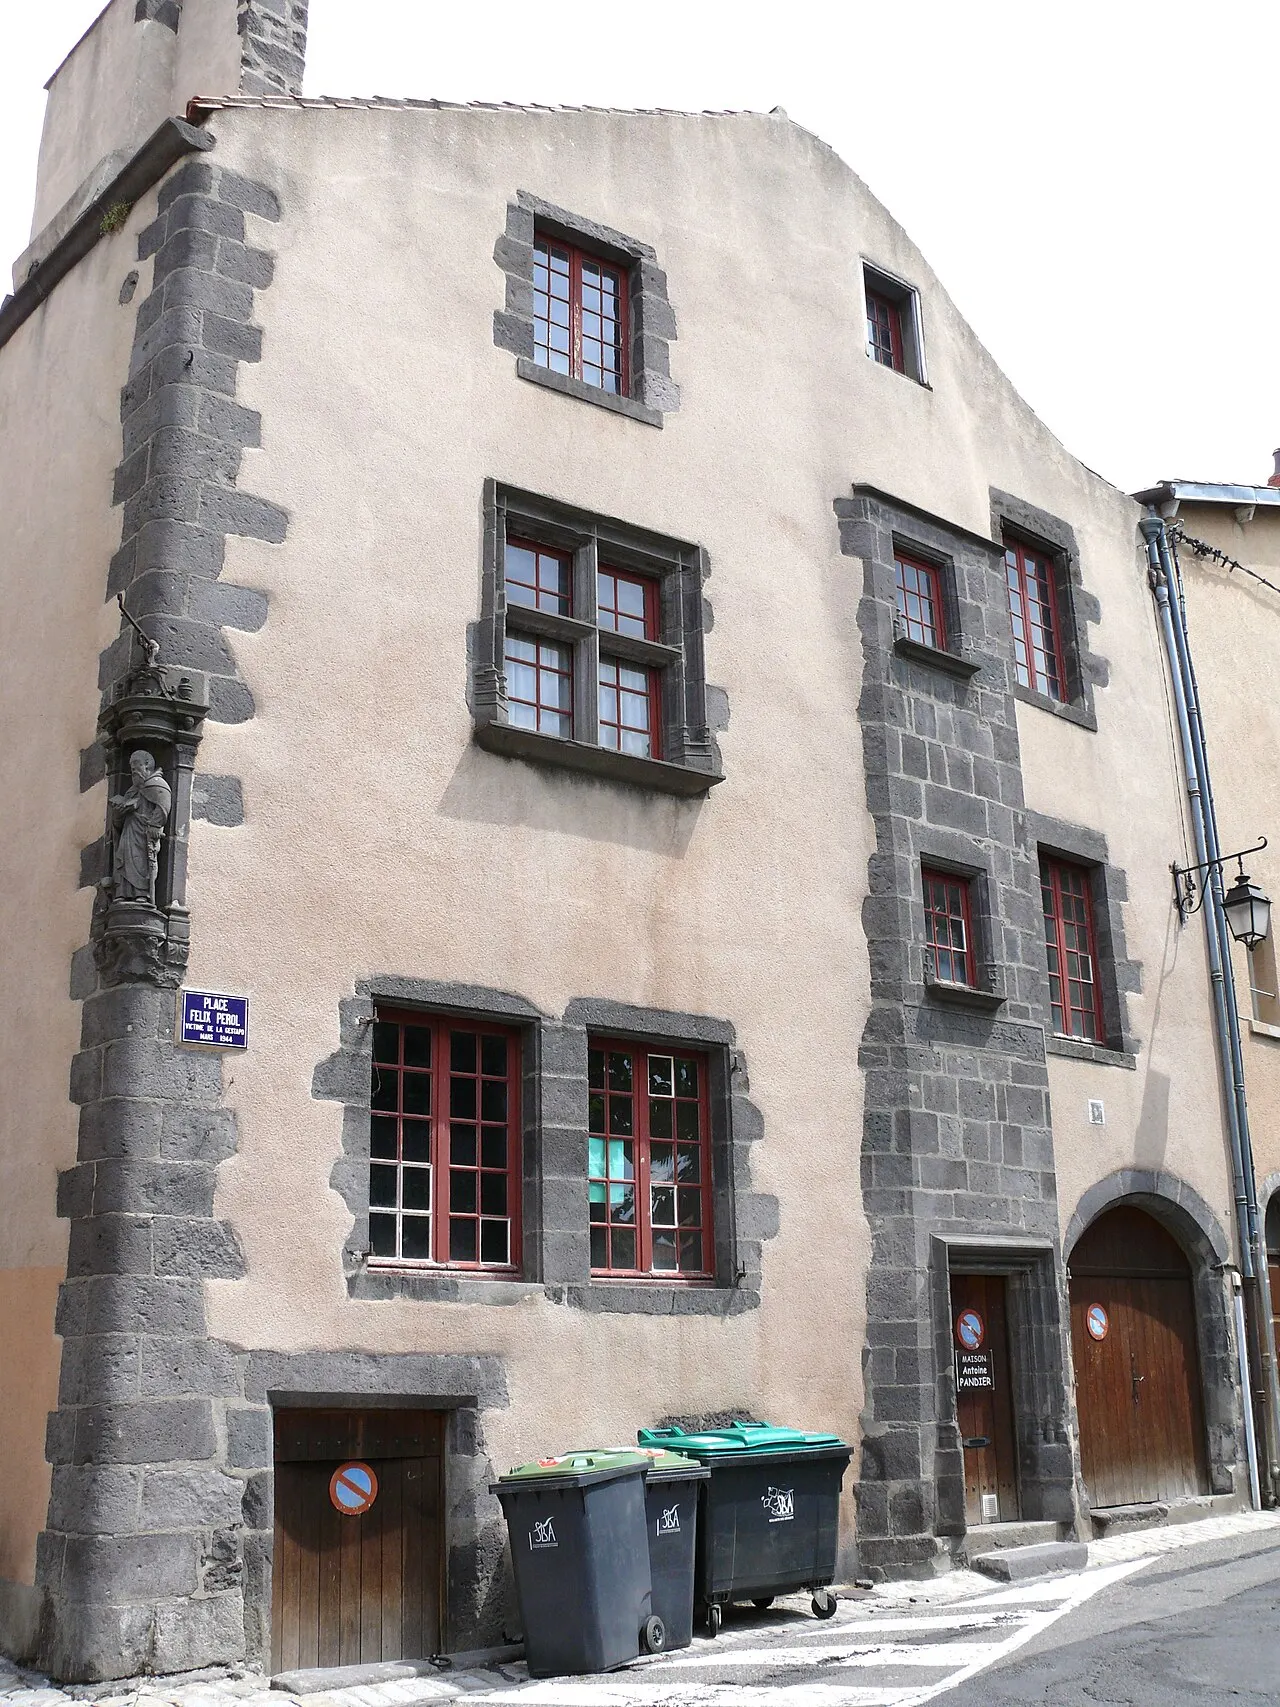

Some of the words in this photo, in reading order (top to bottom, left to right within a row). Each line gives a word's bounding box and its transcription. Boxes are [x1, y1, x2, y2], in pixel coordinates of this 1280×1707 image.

[204, 997, 228, 1011] PLACE
[190, 1009, 211, 1023] FELIX
[216, 1012, 240, 1026] PEROL
[185, 1023, 204, 1031] VICTIME
[224, 1027, 244, 1035] GESTAPO
[961, 1355, 987, 1363] MAISON
[962, 1366, 988, 1375] Antoine
[960, 1377, 992, 1387] PANDIER
